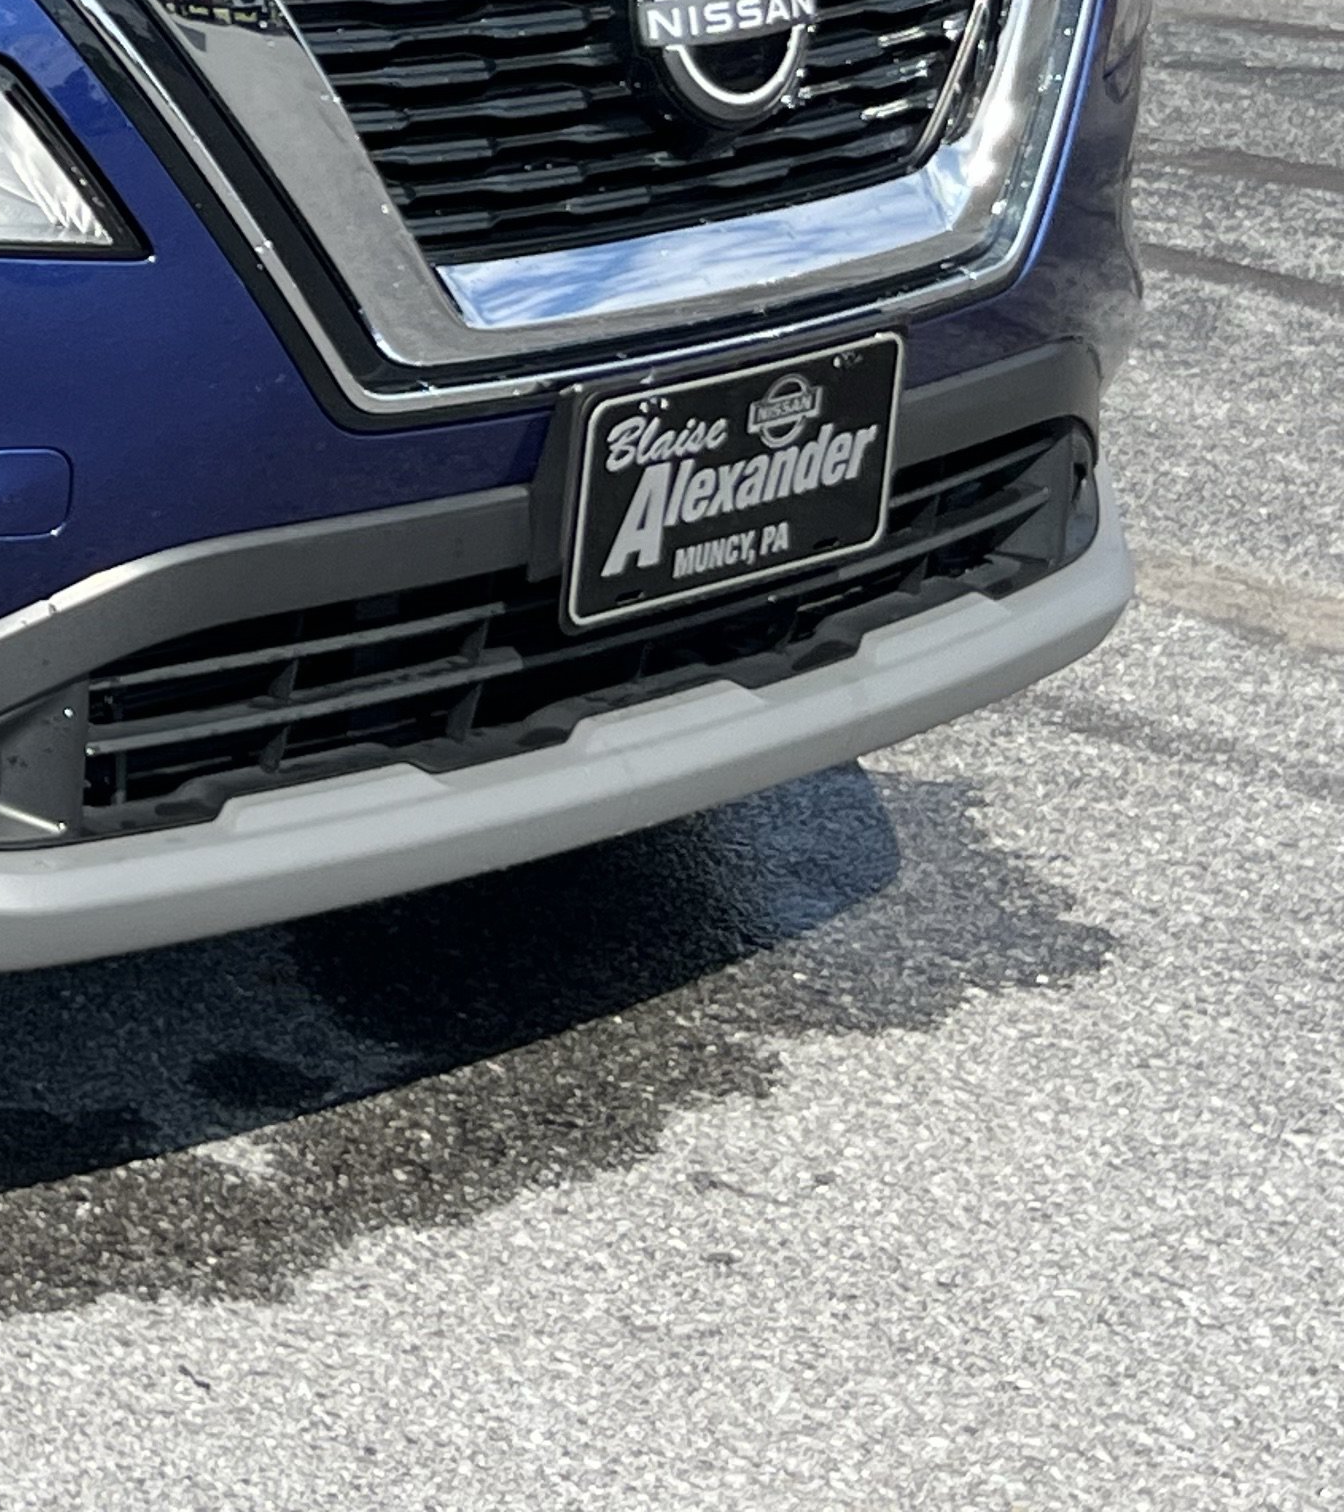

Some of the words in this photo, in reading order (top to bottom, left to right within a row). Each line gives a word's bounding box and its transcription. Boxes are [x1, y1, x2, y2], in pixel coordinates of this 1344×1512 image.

[755, 393, 813, 423] NISSAN
[606, 415, 728, 472] Blaise
[600, 423, 878, 577] Alexander
[672, 529, 758, 578] MUNCY,
[759, 521, 789, 555] PA
